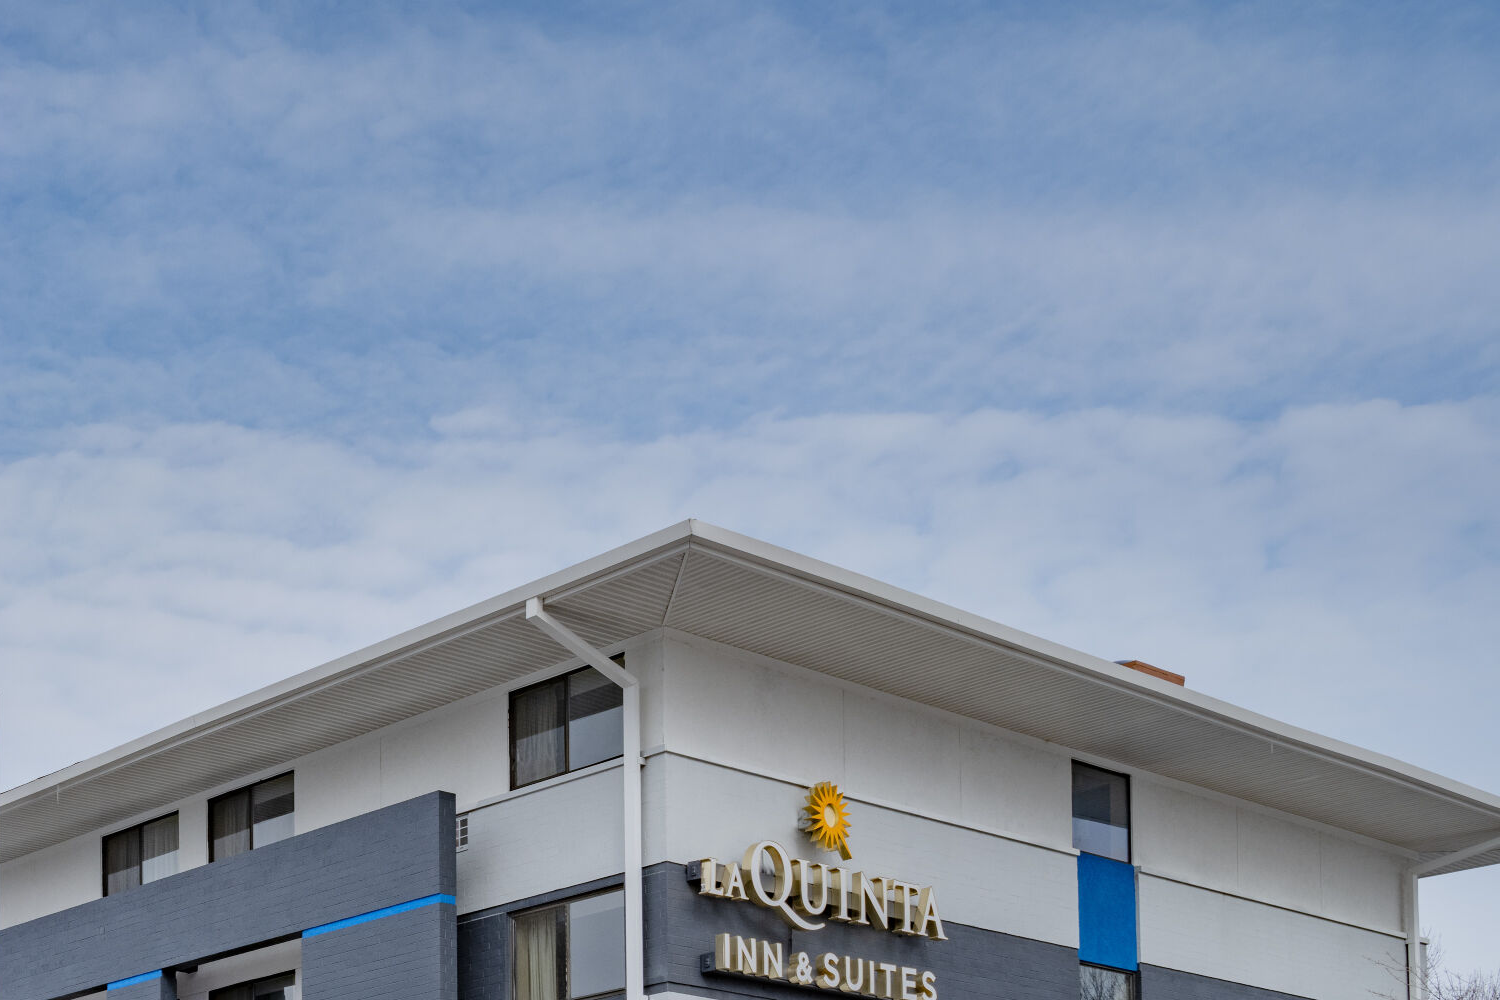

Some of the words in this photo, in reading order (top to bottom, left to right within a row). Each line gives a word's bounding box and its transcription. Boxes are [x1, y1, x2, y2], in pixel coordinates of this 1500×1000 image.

[700, 857, 749, 900] LA
[743, 840, 948, 940] QUINTA
[717, 933, 783, 978] INN
[789, 952, 813, 985] &
